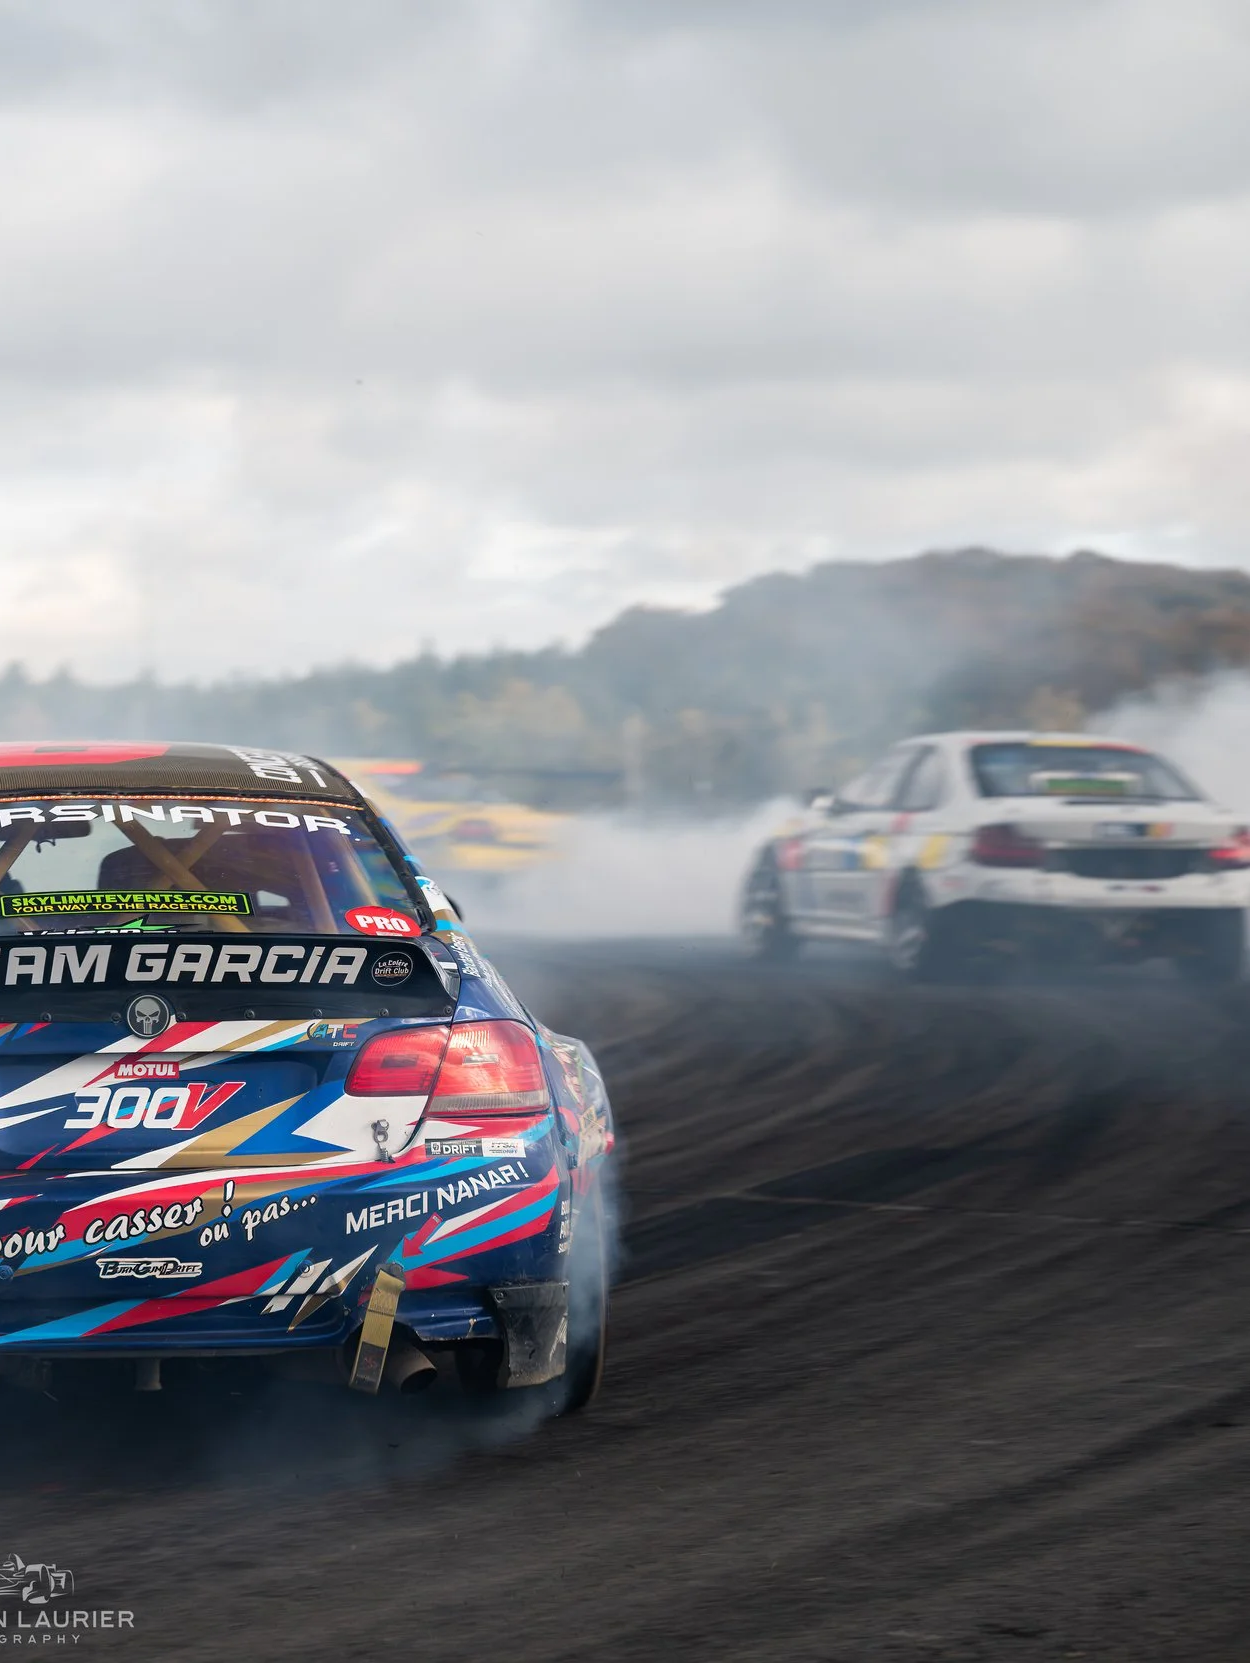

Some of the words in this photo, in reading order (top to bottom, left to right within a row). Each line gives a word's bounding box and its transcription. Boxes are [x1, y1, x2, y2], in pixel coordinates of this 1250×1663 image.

[12, 894, 238, 908] SKYLIMITEVENTS.COM
[13, 905, 55, 913] YOUR
[57, 904, 90, 912] WAY
[92, 903, 113, 911] TO
[149, 902, 239, 912] RACETRACK
[355, 914, 411, 932] PRO
[124, 944, 368, 984] GARCIA
[374, 967, 391, 975] Drift
[117, 1063, 177, 1077] MOTUL
[63, 1081, 247, 1131] 300V
[442, 1144, 477, 1155] DRIFT
[345, 1190, 429, 1235] MERCI
[436, 1163, 519, 1210] NANAR
[516, 1160, 530, 1178] !
[83, 1197, 203, 1244] casser
[199, 1220, 230, 1247] ou
[241, 1195, 317, 1241] pas...
